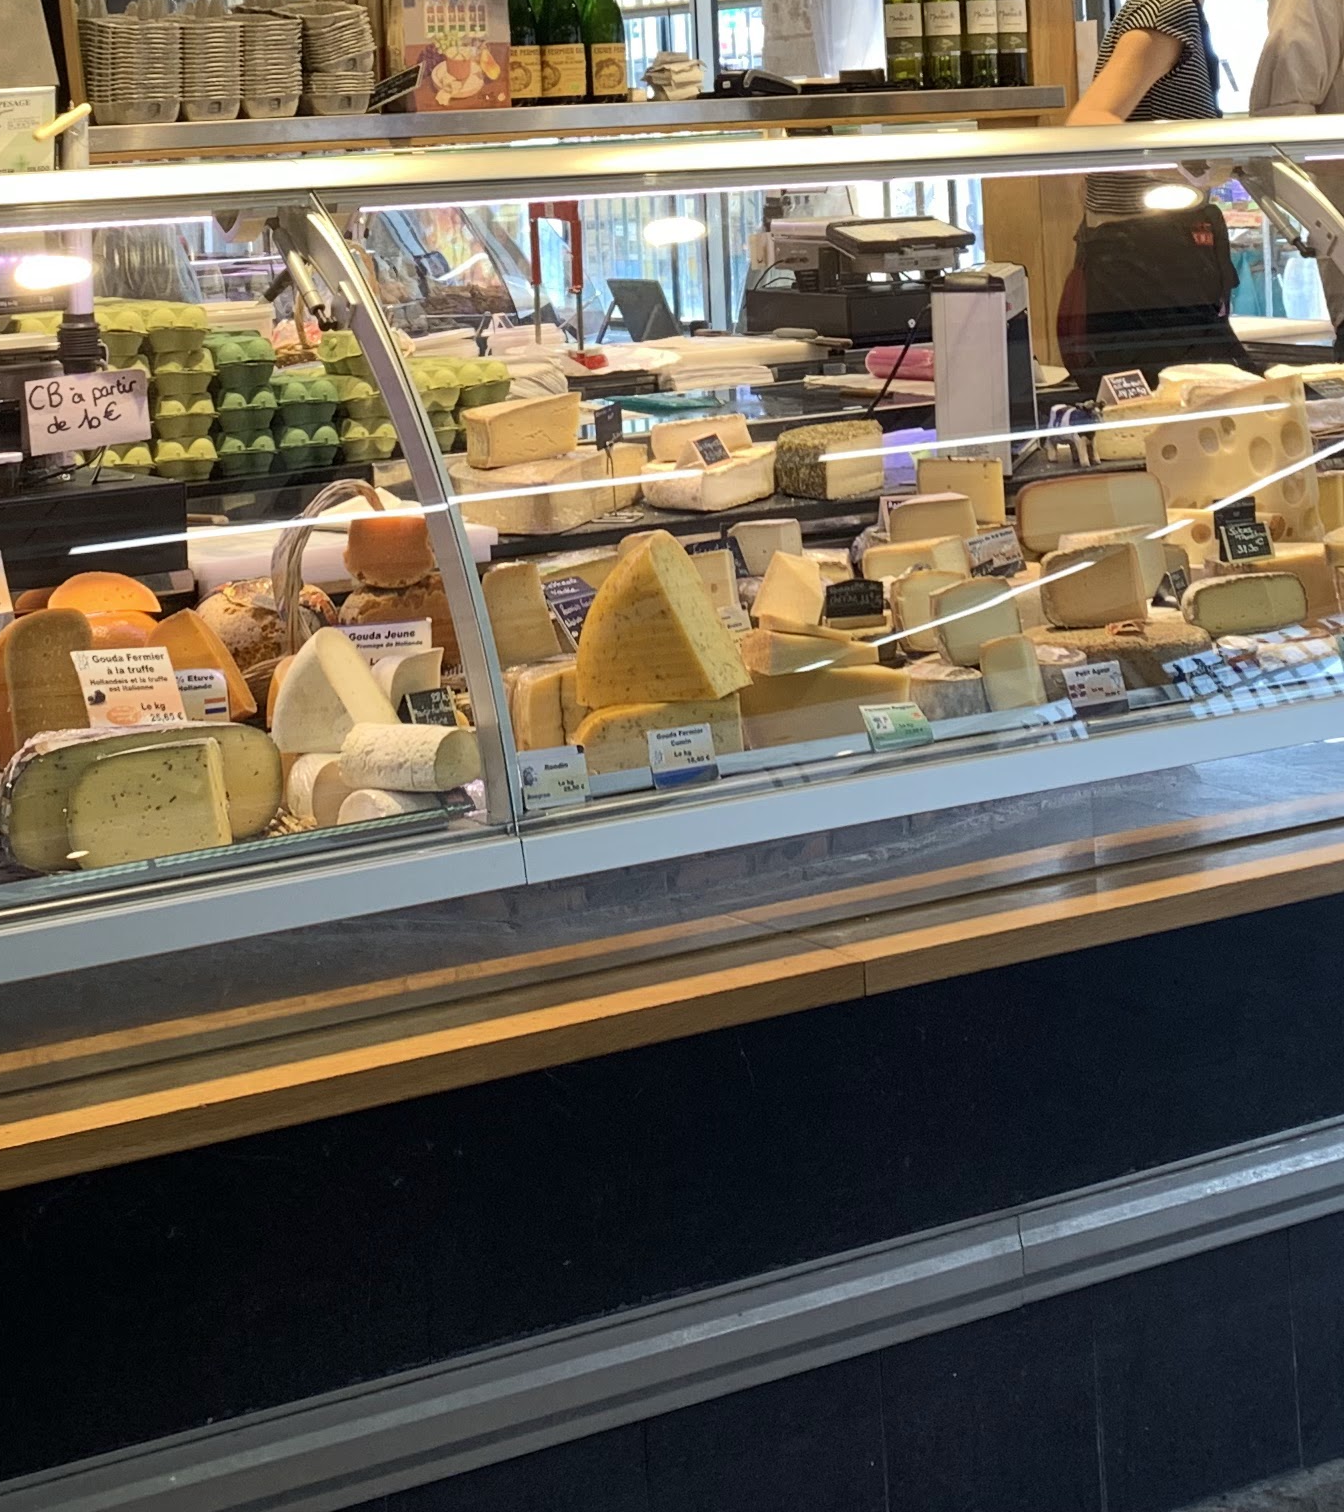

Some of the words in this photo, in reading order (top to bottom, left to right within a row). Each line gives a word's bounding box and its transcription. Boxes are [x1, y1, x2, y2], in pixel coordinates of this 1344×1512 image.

[28, 381, 64, 411] CB
[69, 387, 86, 404] à
[92, 376, 137, 407] partir
[47, 416, 71, 434] de
[78, 401, 122, 430] 10€
[349, 631, 382, 642] Gouda
[384, 629, 416, 640] Jeune
[91, 654, 124, 664] Gouda
[126, 652, 165, 662] Fermier
[107, 665, 113, 676] à
[116, 665, 125, 675] la
[126, 665, 155, 675] truffe
[140, 702, 154, 712] Le
[155, 701, 166, 713] kg
[656, 731, 677, 741] Gouda
[678, 727, 703, 738] Fermier
[544, 762, 569, 771] Rondin
